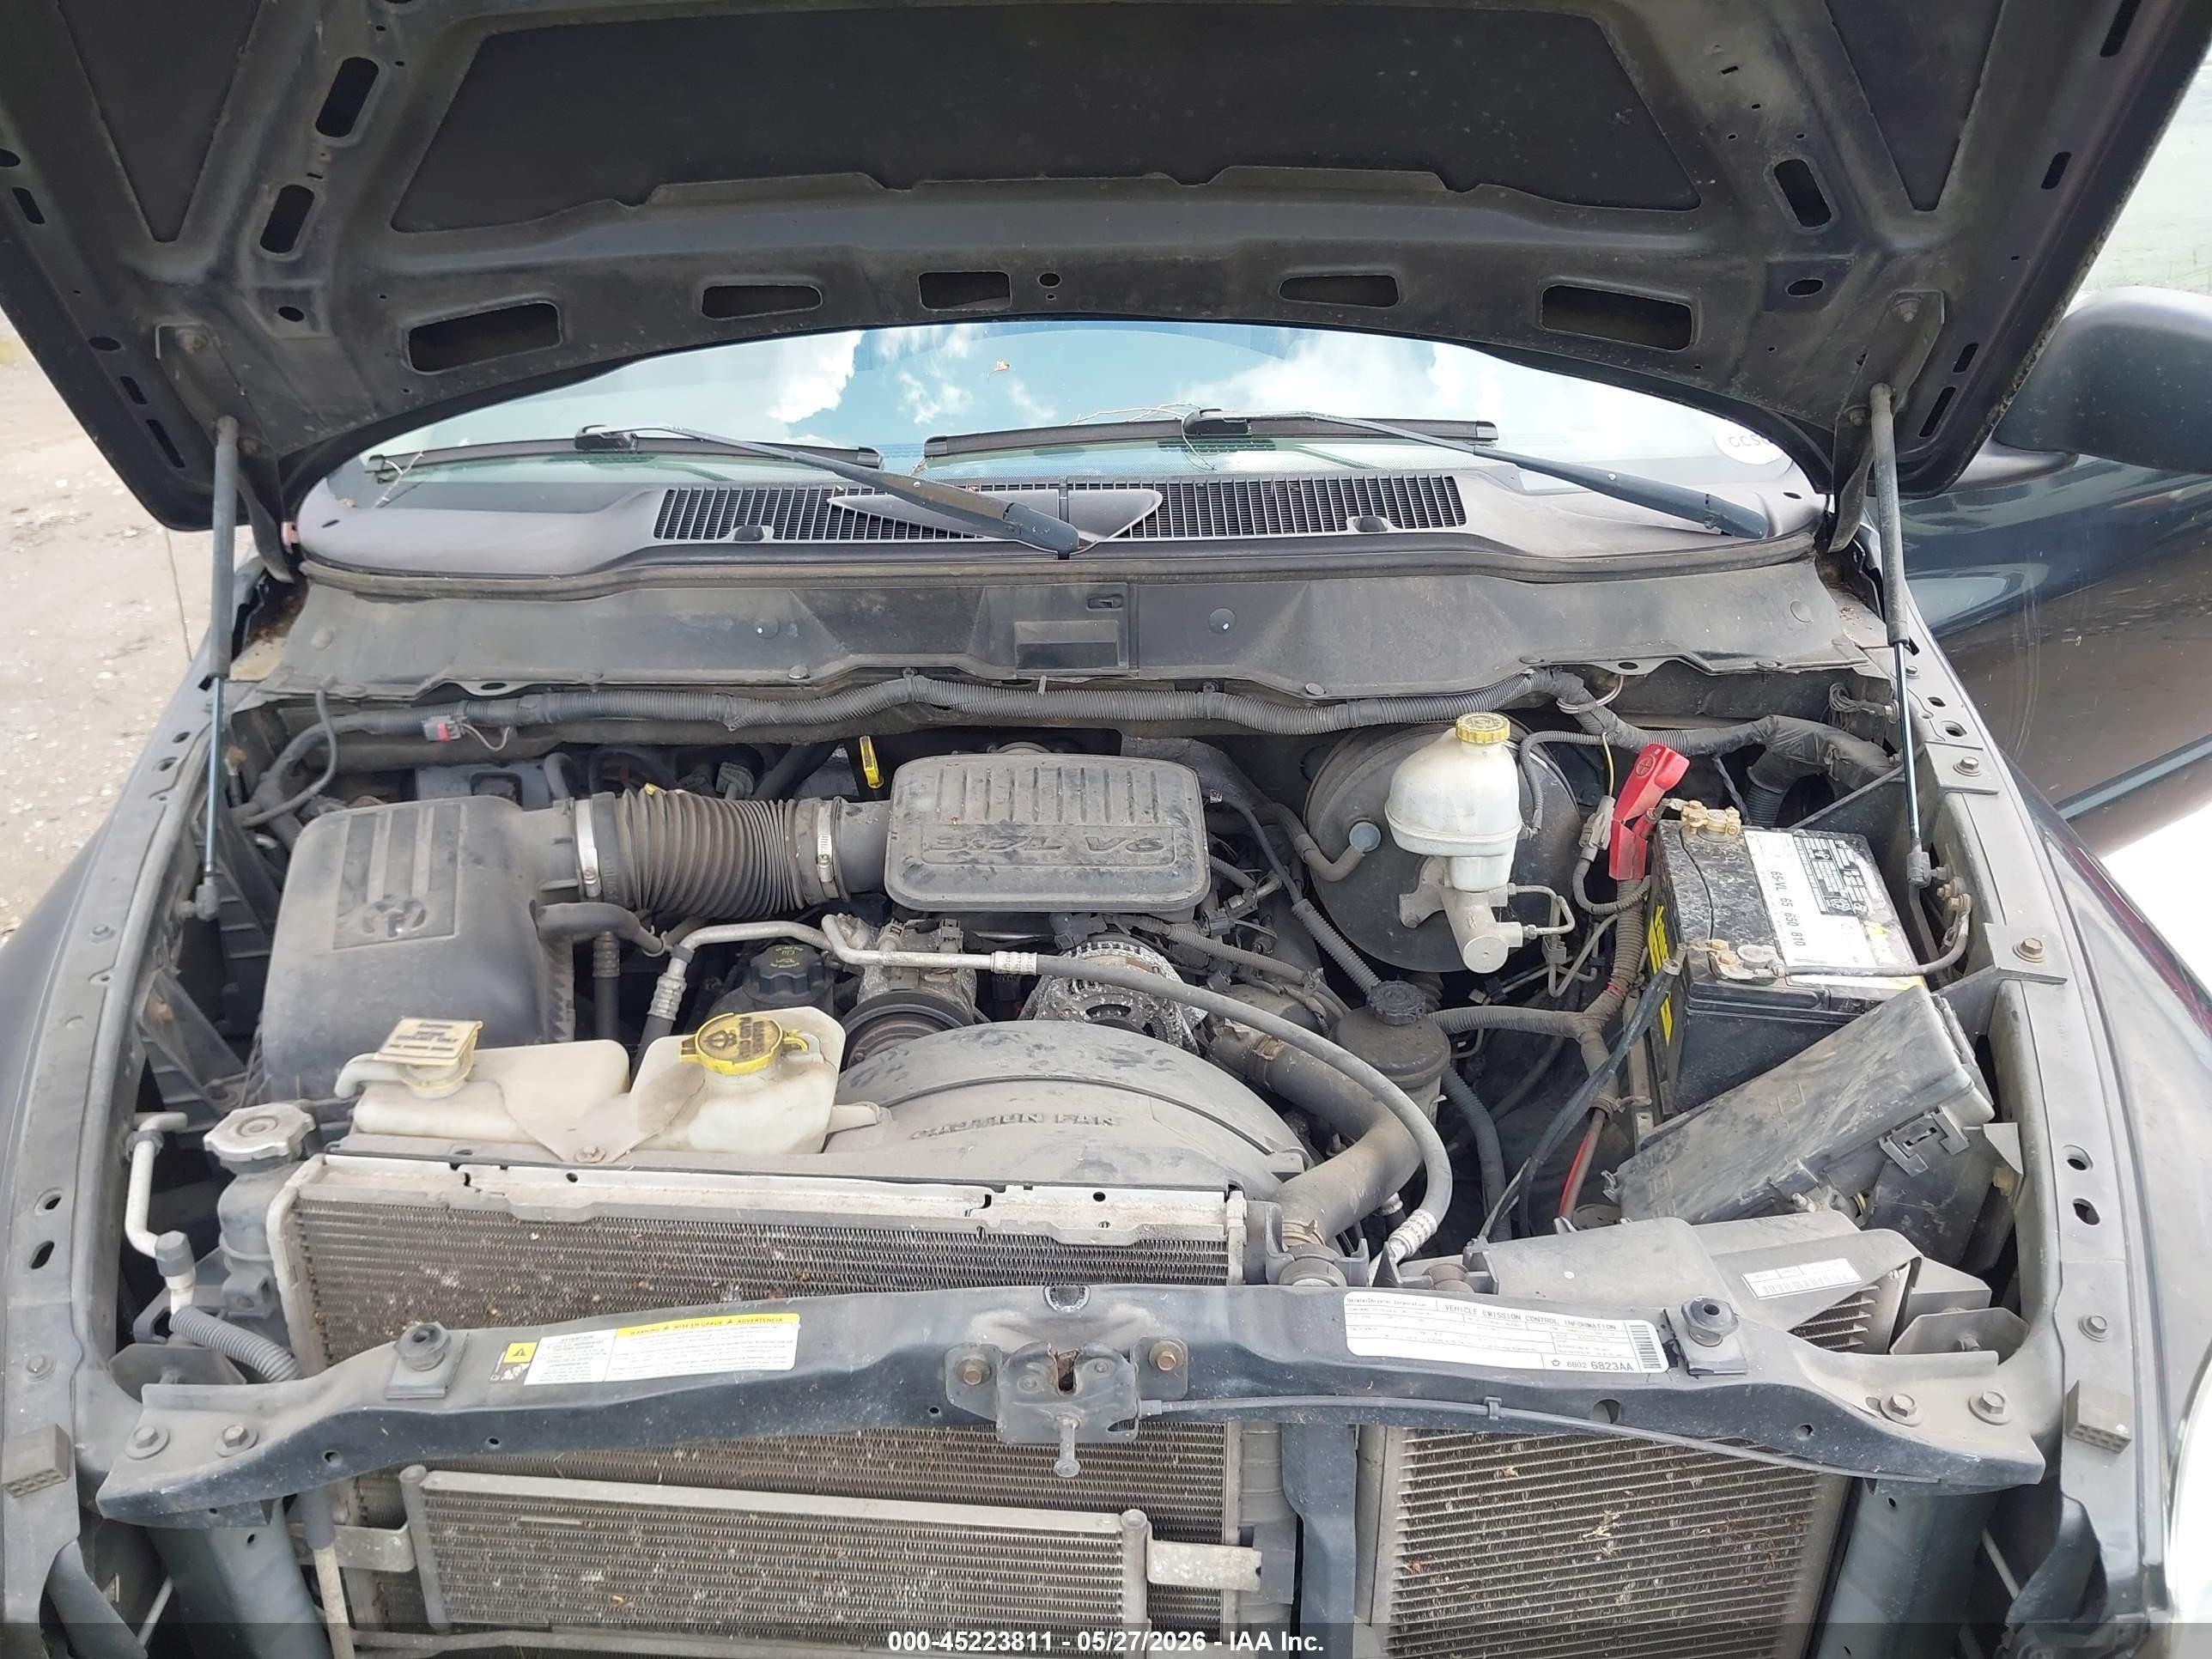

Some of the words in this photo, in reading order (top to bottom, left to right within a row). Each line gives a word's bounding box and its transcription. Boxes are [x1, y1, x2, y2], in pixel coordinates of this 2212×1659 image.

[1085, 836, 1164, 854] V6
[1780, 897, 1793, 907] 65
[1784, 912, 1799, 927] 650
[1790, 932, 1807, 946] 810
[908, 1113, 1045, 1140] CAUTION
[1054, 1113, 1118, 1127] FAN
[1445, 1304, 1478, 1315] VEHICLE
[1482, 1310, 1522, 1321] EMISSION
[1524, 1315, 1559, 1325] CONTROL
[1565, 1320, 1616, 1330] INFORMATION
[1566, 1360, 1588, 1369] 6802
[1590, 1361, 1634, 1371] 6823AA
